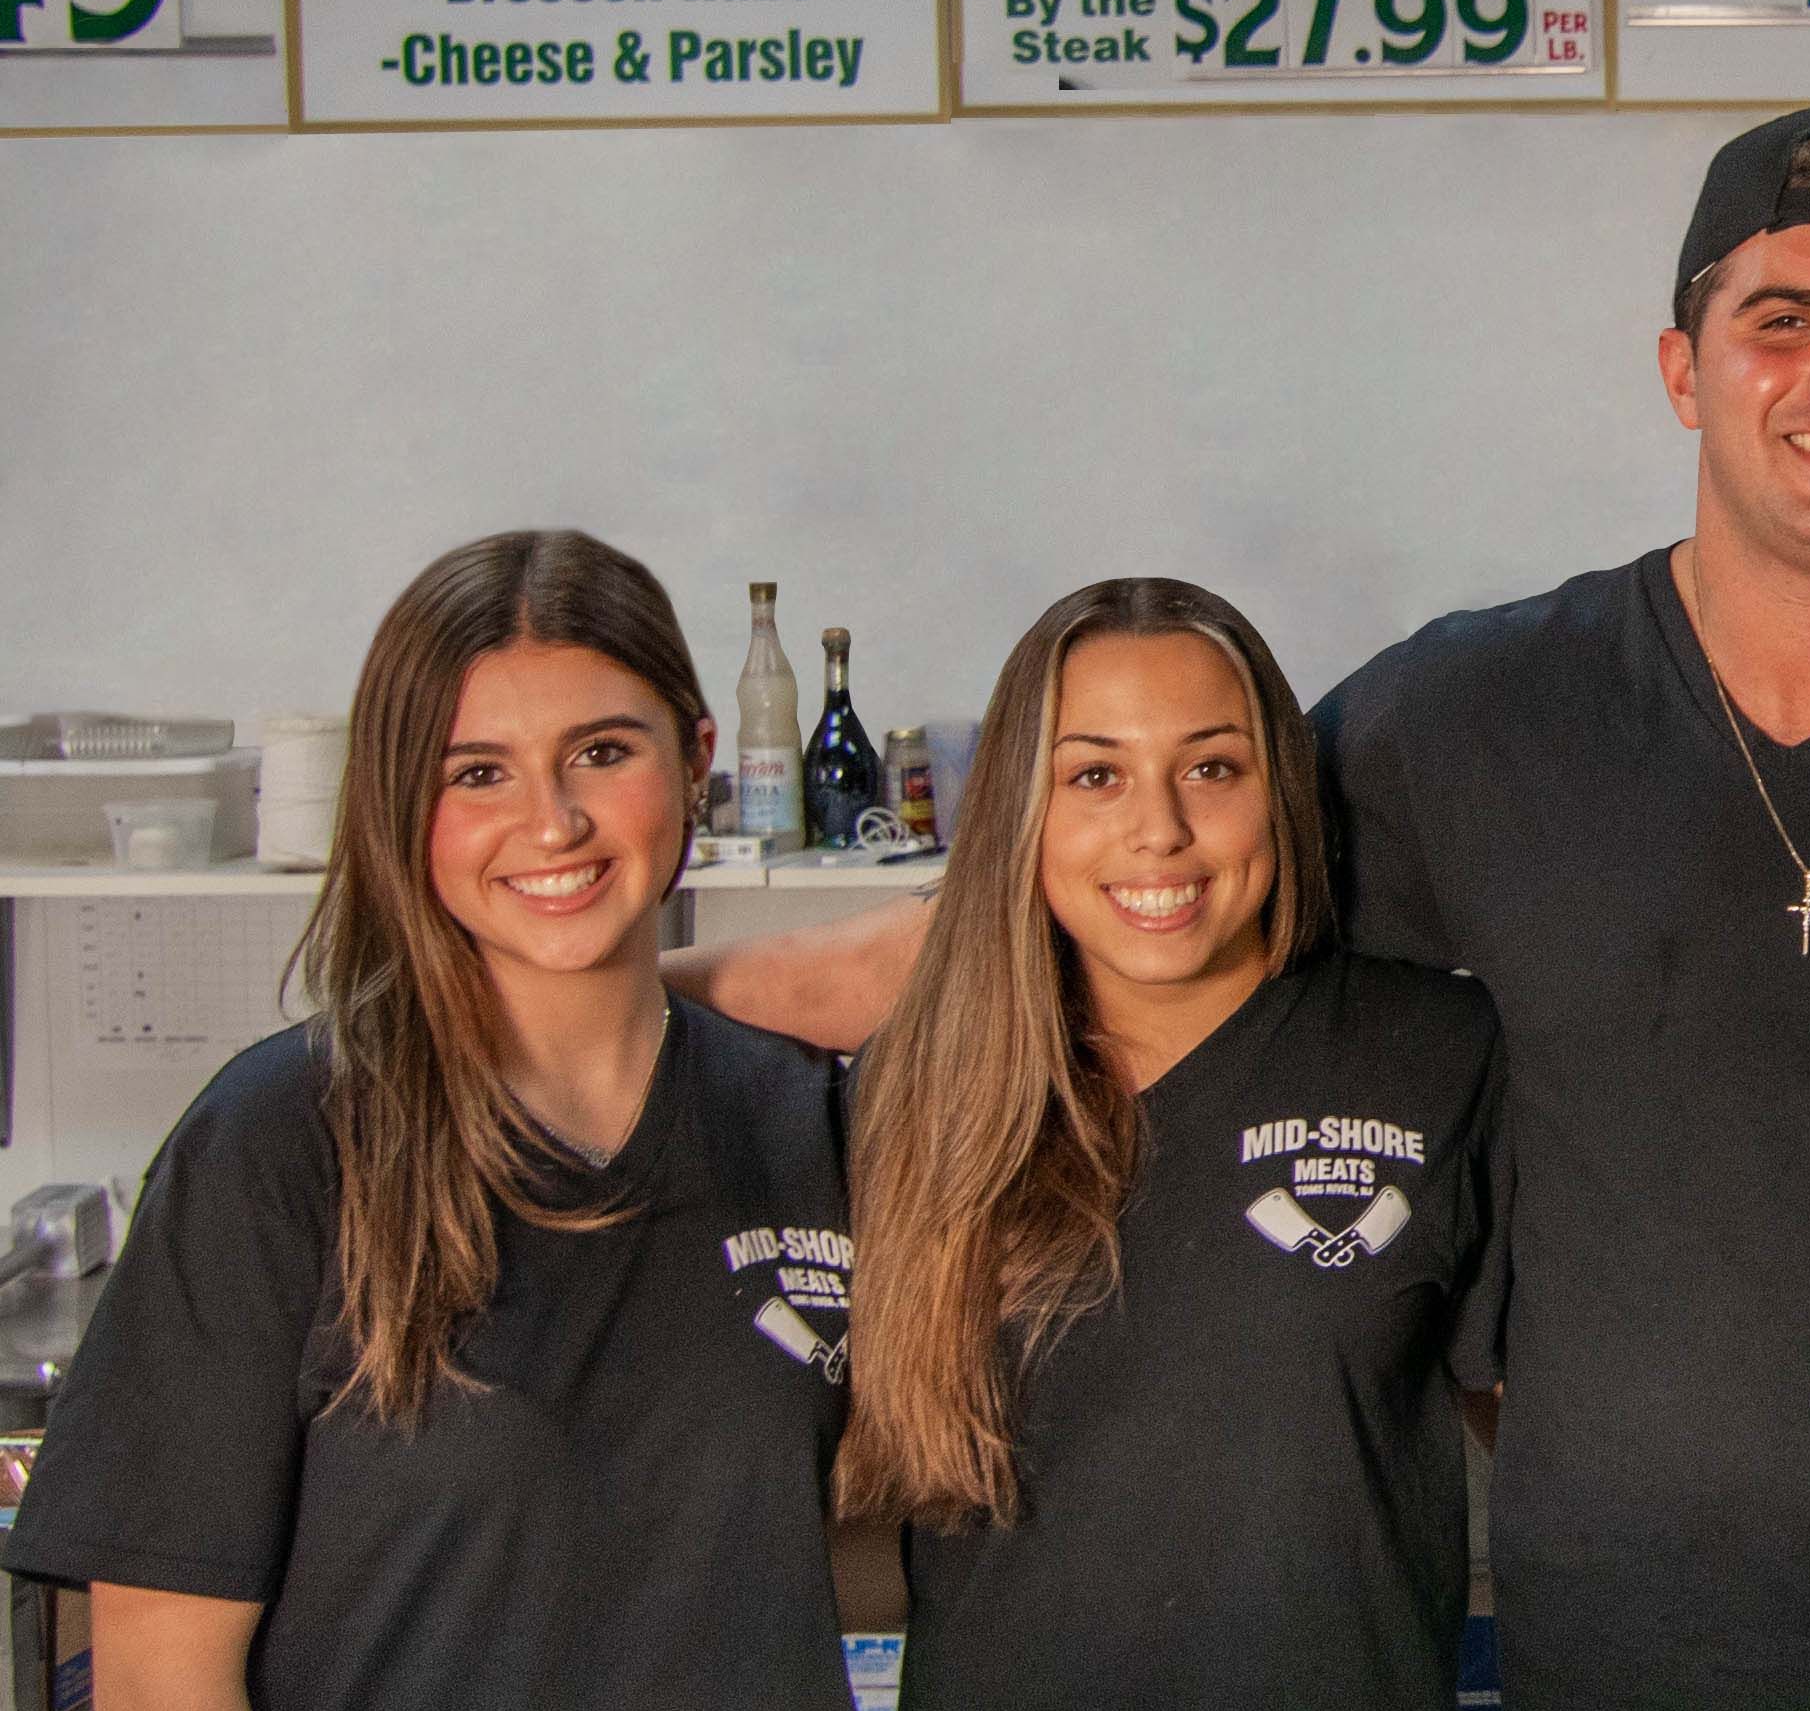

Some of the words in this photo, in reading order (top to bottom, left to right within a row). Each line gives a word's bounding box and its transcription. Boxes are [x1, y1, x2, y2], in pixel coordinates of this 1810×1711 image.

[1543, 10, 1588, 35] PER
[613, 30, 652, 83] &
[667, 28, 867, 88] Parsley
[1011, 28, 1152, 64] Steak
[1547, 38, 1586, 63] LB.
[1241, 1116, 1425, 1165] MID-SHORE
[1293, 1158, 1376, 1184] MEATS
[723, 1226, 855, 1273] MID-SHOR
[777, 1266, 846, 1296] MEATS
